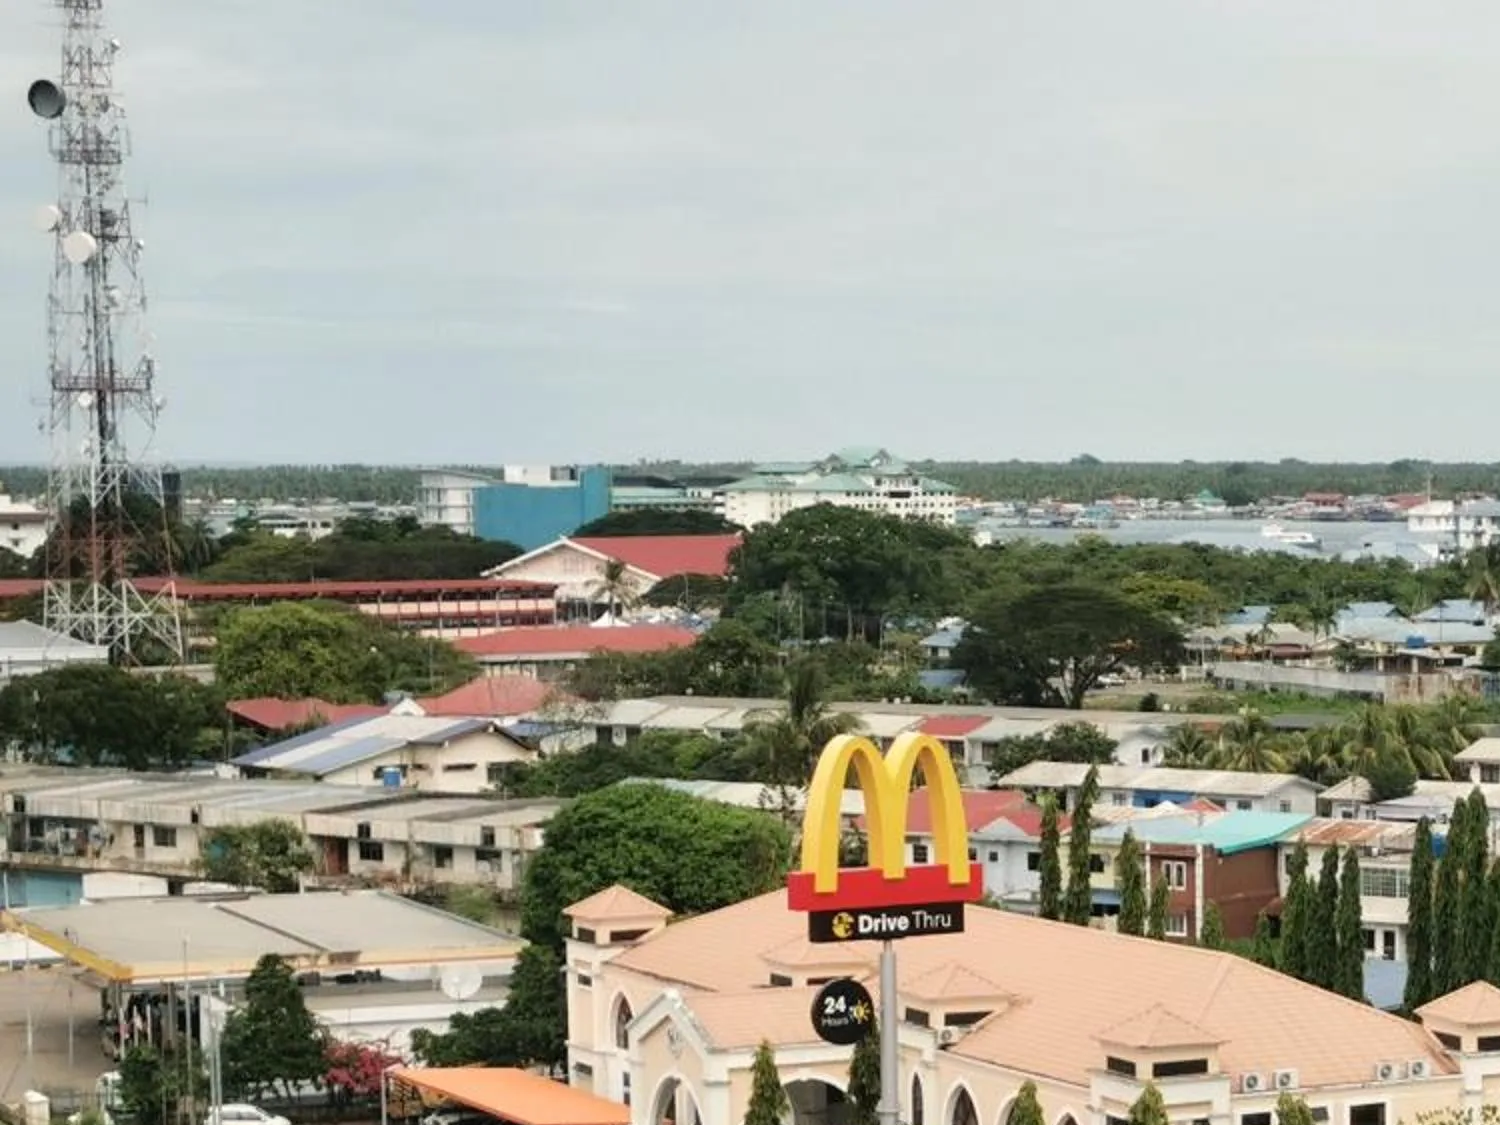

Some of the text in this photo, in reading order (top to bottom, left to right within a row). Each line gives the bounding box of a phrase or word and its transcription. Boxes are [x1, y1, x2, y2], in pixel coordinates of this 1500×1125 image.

[858, 909, 951, 934] Drive Thru
[824, 995, 847, 1015] 24
